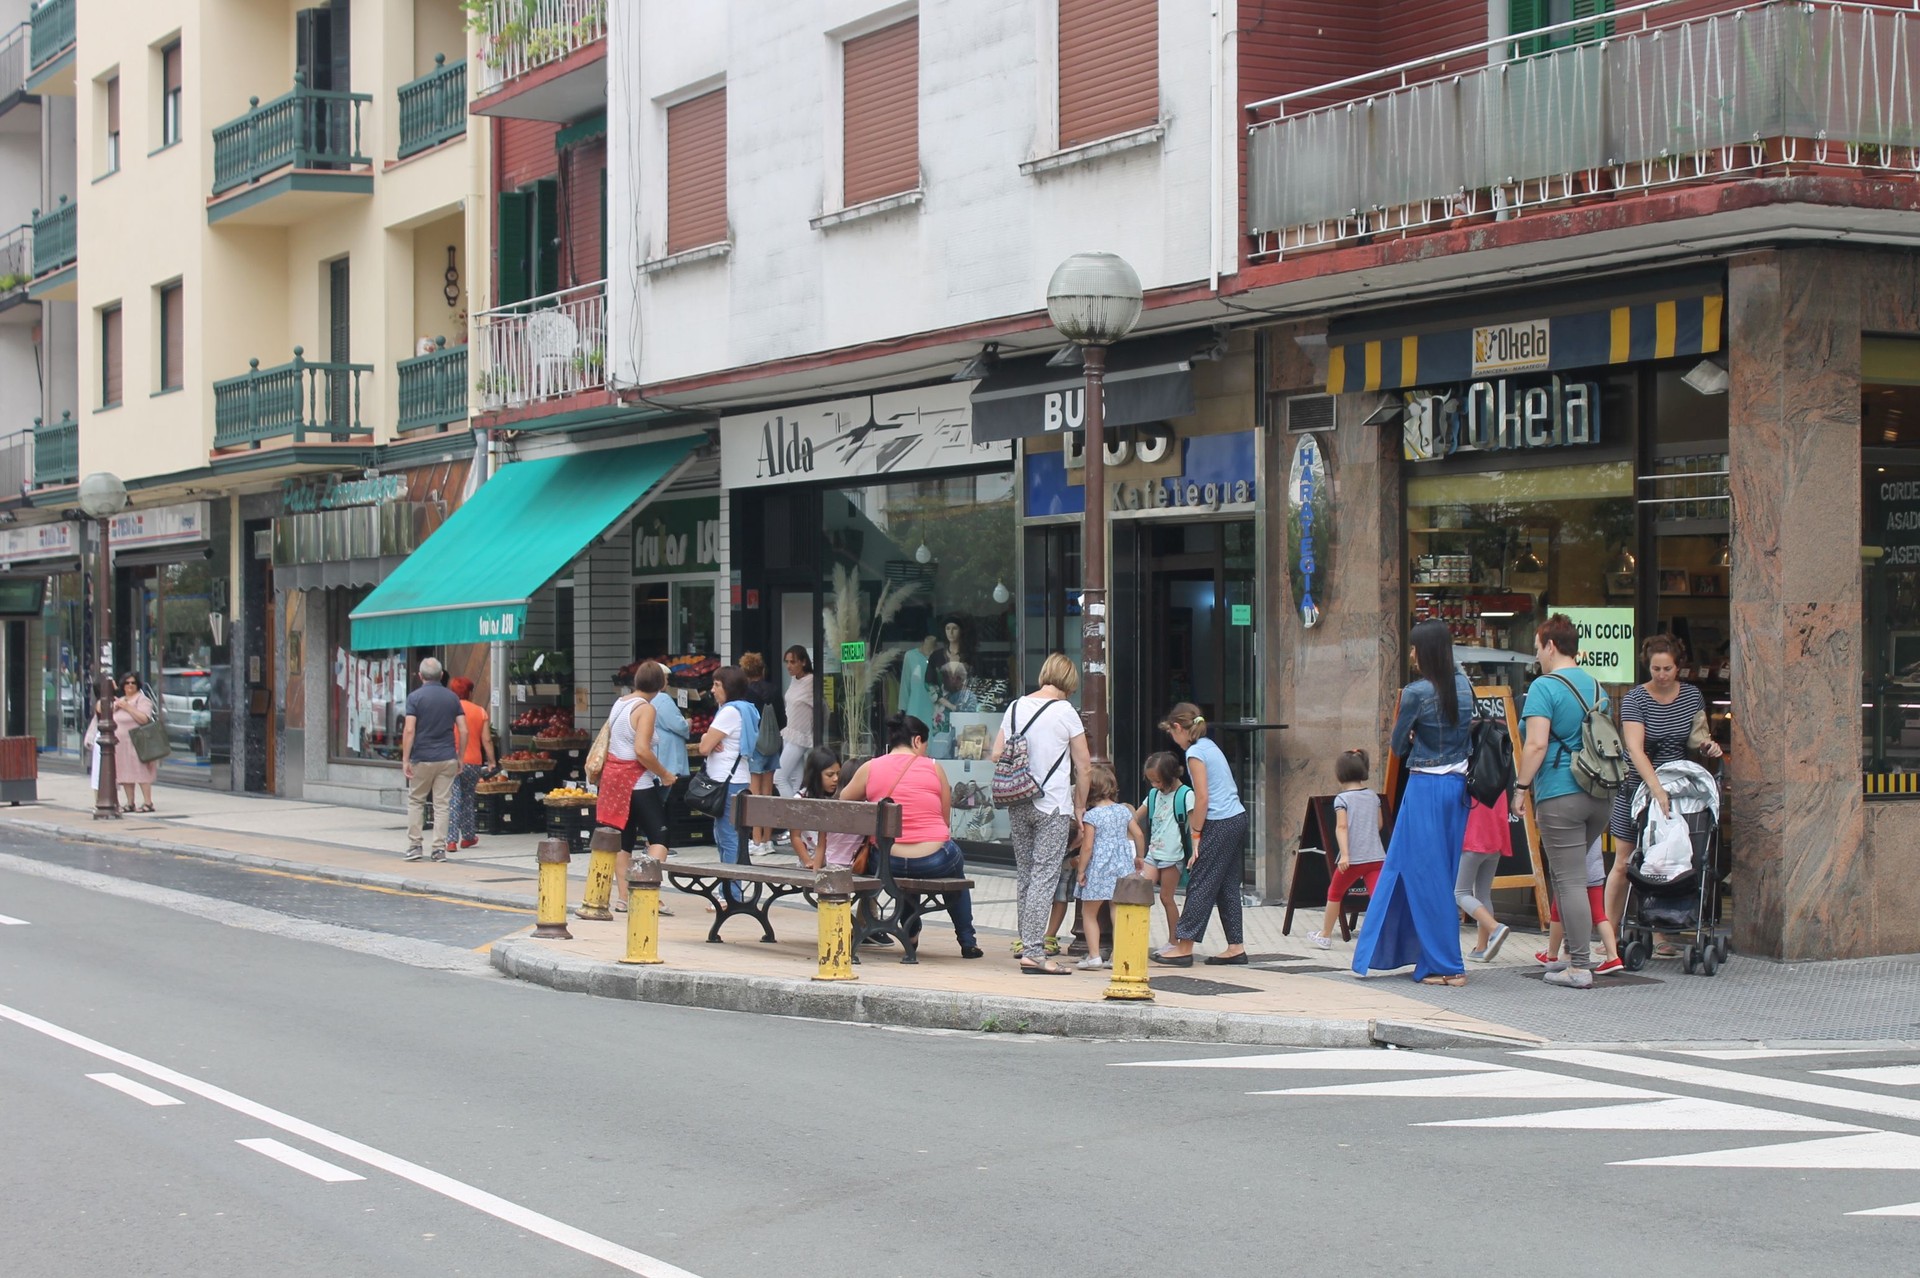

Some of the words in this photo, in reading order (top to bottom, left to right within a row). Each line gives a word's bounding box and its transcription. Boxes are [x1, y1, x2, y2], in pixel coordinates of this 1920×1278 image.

[1498, 324, 1547, 361] Okela
[1044, 388, 1106, 431] BU
[1468, 375, 1590, 450] Okela
[757, 416, 815, 478] Alda
[1575, 620, 1592, 639] ÓN
[1596, 624, 1634, 639] COCID
[1575, 651, 1619, 667] CASERO
